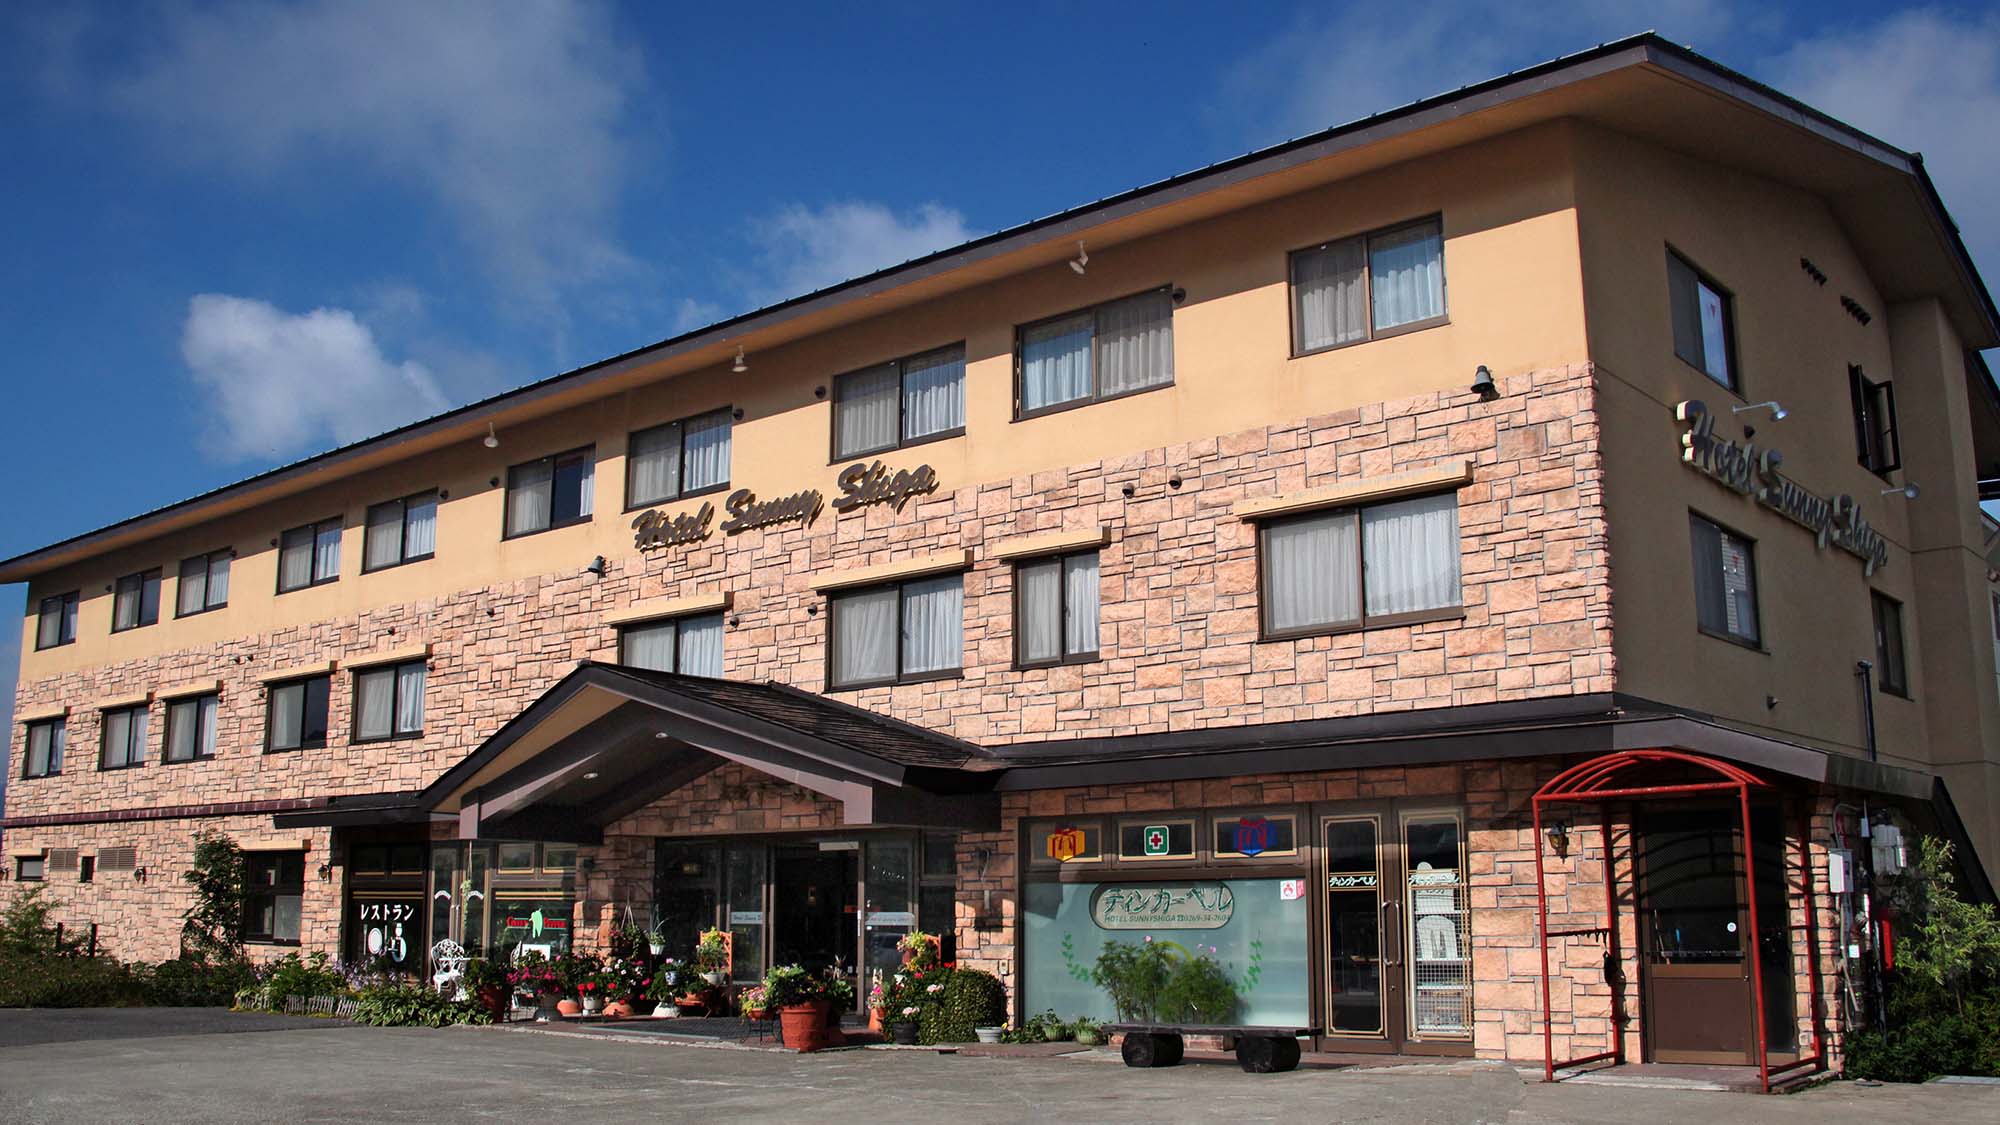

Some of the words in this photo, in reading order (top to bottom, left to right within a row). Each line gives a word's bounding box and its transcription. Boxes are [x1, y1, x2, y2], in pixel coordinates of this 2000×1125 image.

[1676, 400, 1755, 494] Hotel
[1755, 449, 1831, 549] Sunny
[632, 501, 714, 550] Hotel
[720, 488, 824, 534] Sunny
[832, 460, 939, 513] Shiga
[360, 904, 415, 921] レストラン
[1104, 914, 1128, 922] HOTEL
